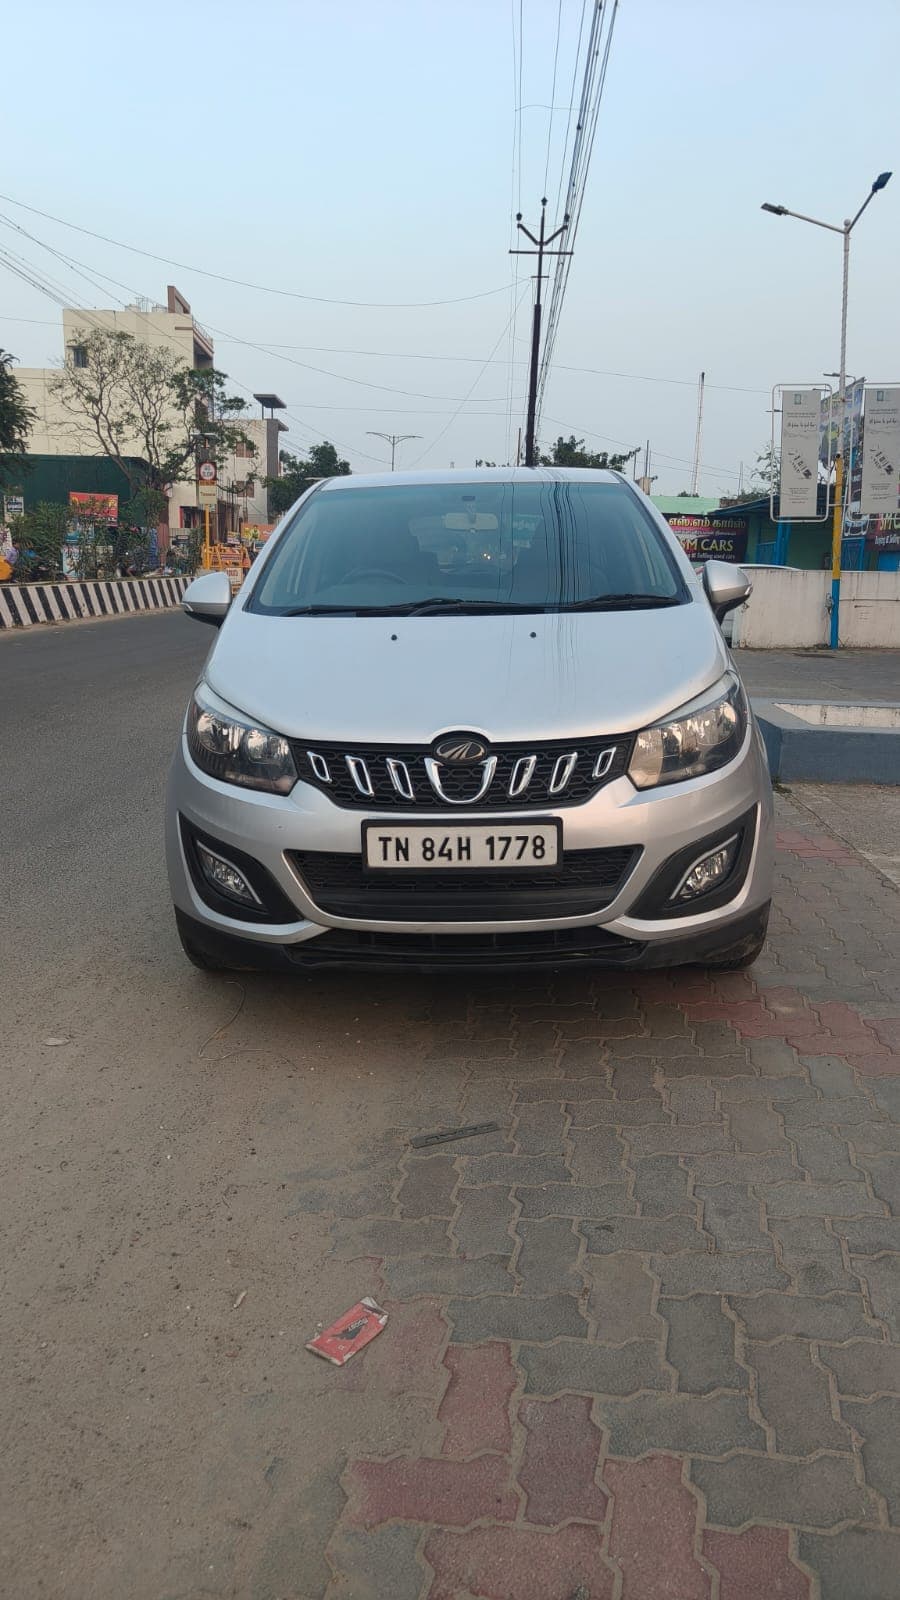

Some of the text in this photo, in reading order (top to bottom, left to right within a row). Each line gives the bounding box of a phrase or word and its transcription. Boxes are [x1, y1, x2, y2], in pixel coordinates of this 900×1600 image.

[701, 539, 733, 552] CARS
[378, 835, 546, 862] TN 84H 1778
